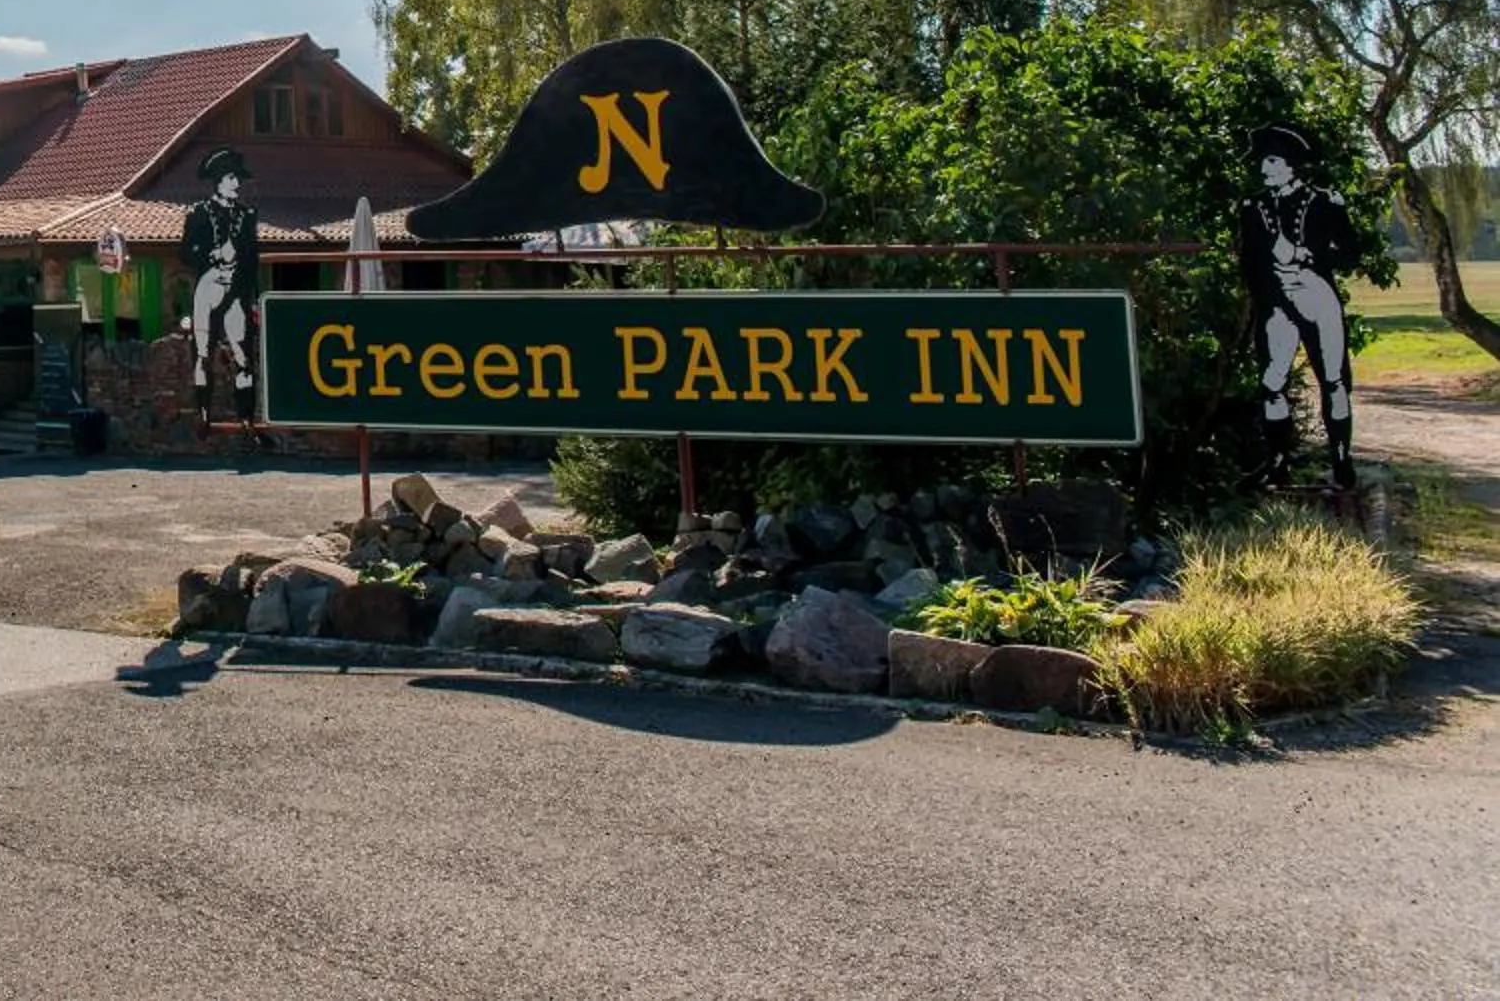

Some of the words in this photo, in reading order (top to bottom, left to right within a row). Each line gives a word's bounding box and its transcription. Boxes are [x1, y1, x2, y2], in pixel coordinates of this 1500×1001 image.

[579, 90, 670, 193] N
[308, 324, 580, 398] Green
[615, 327, 869, 401] PARK
[907, 328, 1086, 406] INN
